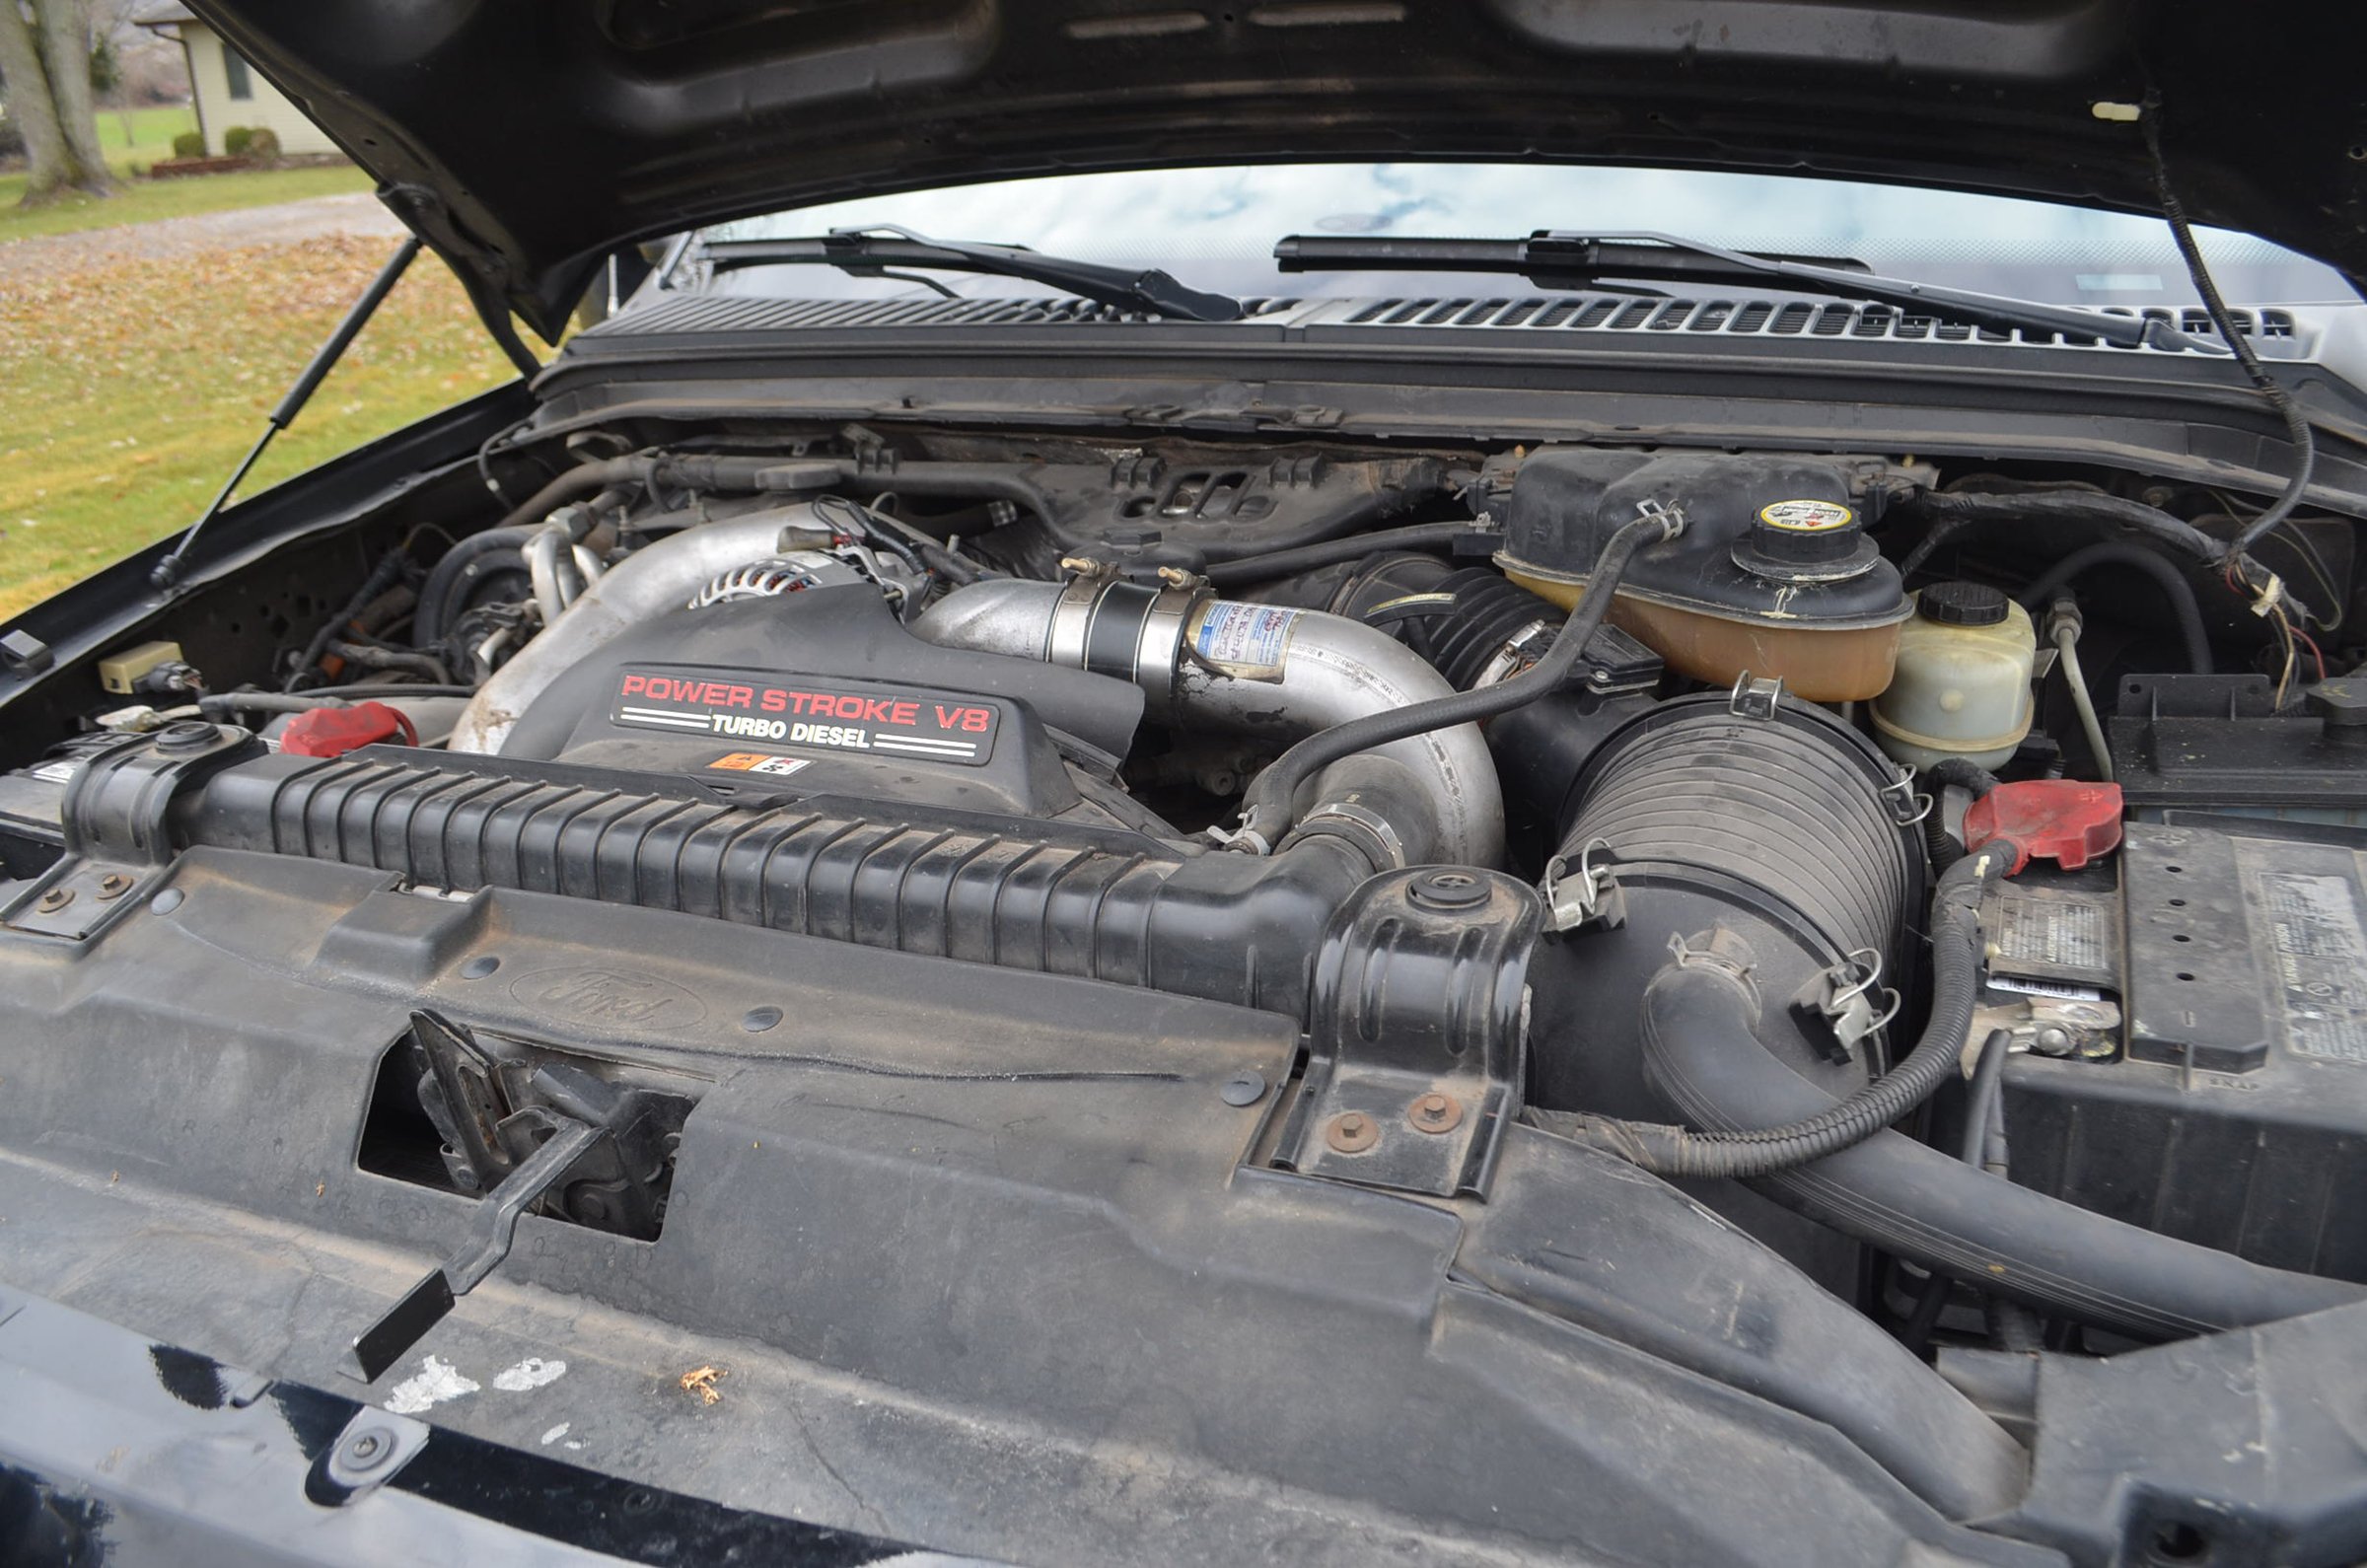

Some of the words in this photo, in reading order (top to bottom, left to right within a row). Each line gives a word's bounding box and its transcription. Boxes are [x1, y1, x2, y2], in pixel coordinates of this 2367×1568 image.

[621, 675, 753, 710] POWER
[760, 688, 920, 726] STROKE
[935, 704, 990, 732] V8
[712, 714, 787, 740] TURBO
[790, 722, 870, 749] DIESEL
[538, 970, 673, 1023] Ford
